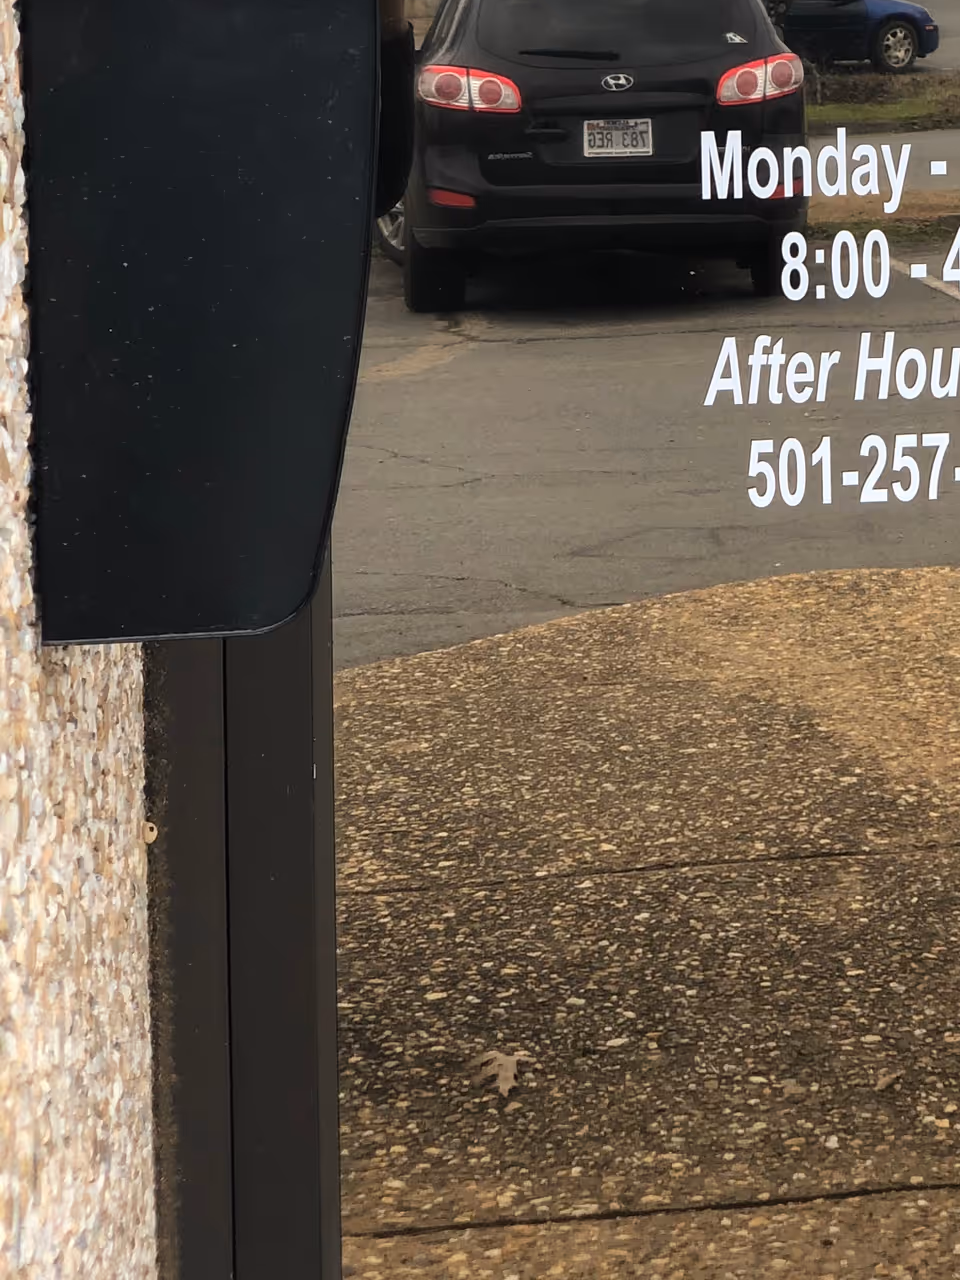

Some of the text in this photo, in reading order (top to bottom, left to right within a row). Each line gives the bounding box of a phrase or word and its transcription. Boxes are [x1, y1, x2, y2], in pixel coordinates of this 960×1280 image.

[700, 127, 911, 214] Monday
[780, 229, 890, 301] 8:00
[703, 334, 842, 406] After
